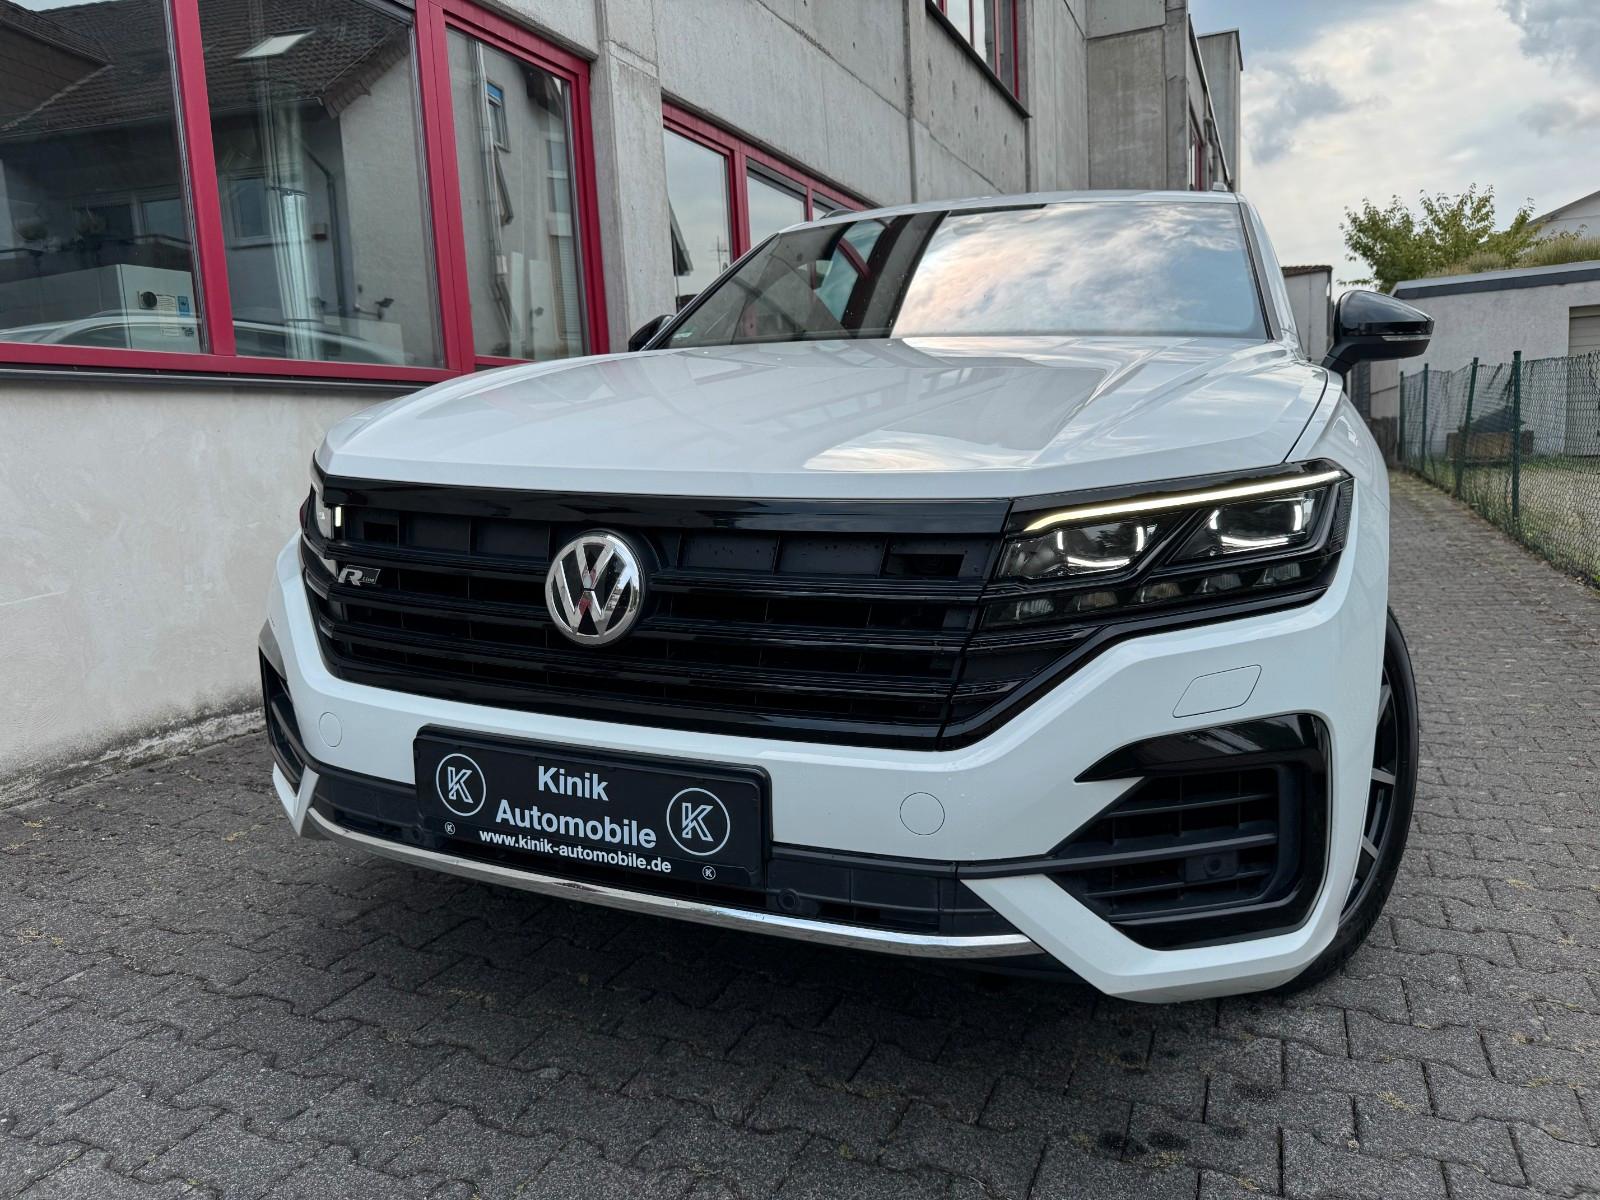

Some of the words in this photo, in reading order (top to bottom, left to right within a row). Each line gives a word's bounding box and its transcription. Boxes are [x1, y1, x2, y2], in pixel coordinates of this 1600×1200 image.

[549, 536, 638, 641] VW
[538, 765, 609, 801] Kinik
[495, 799, 657, 849] Automobile
[479, 829, 672, 873] www.kinik-automobile.de
